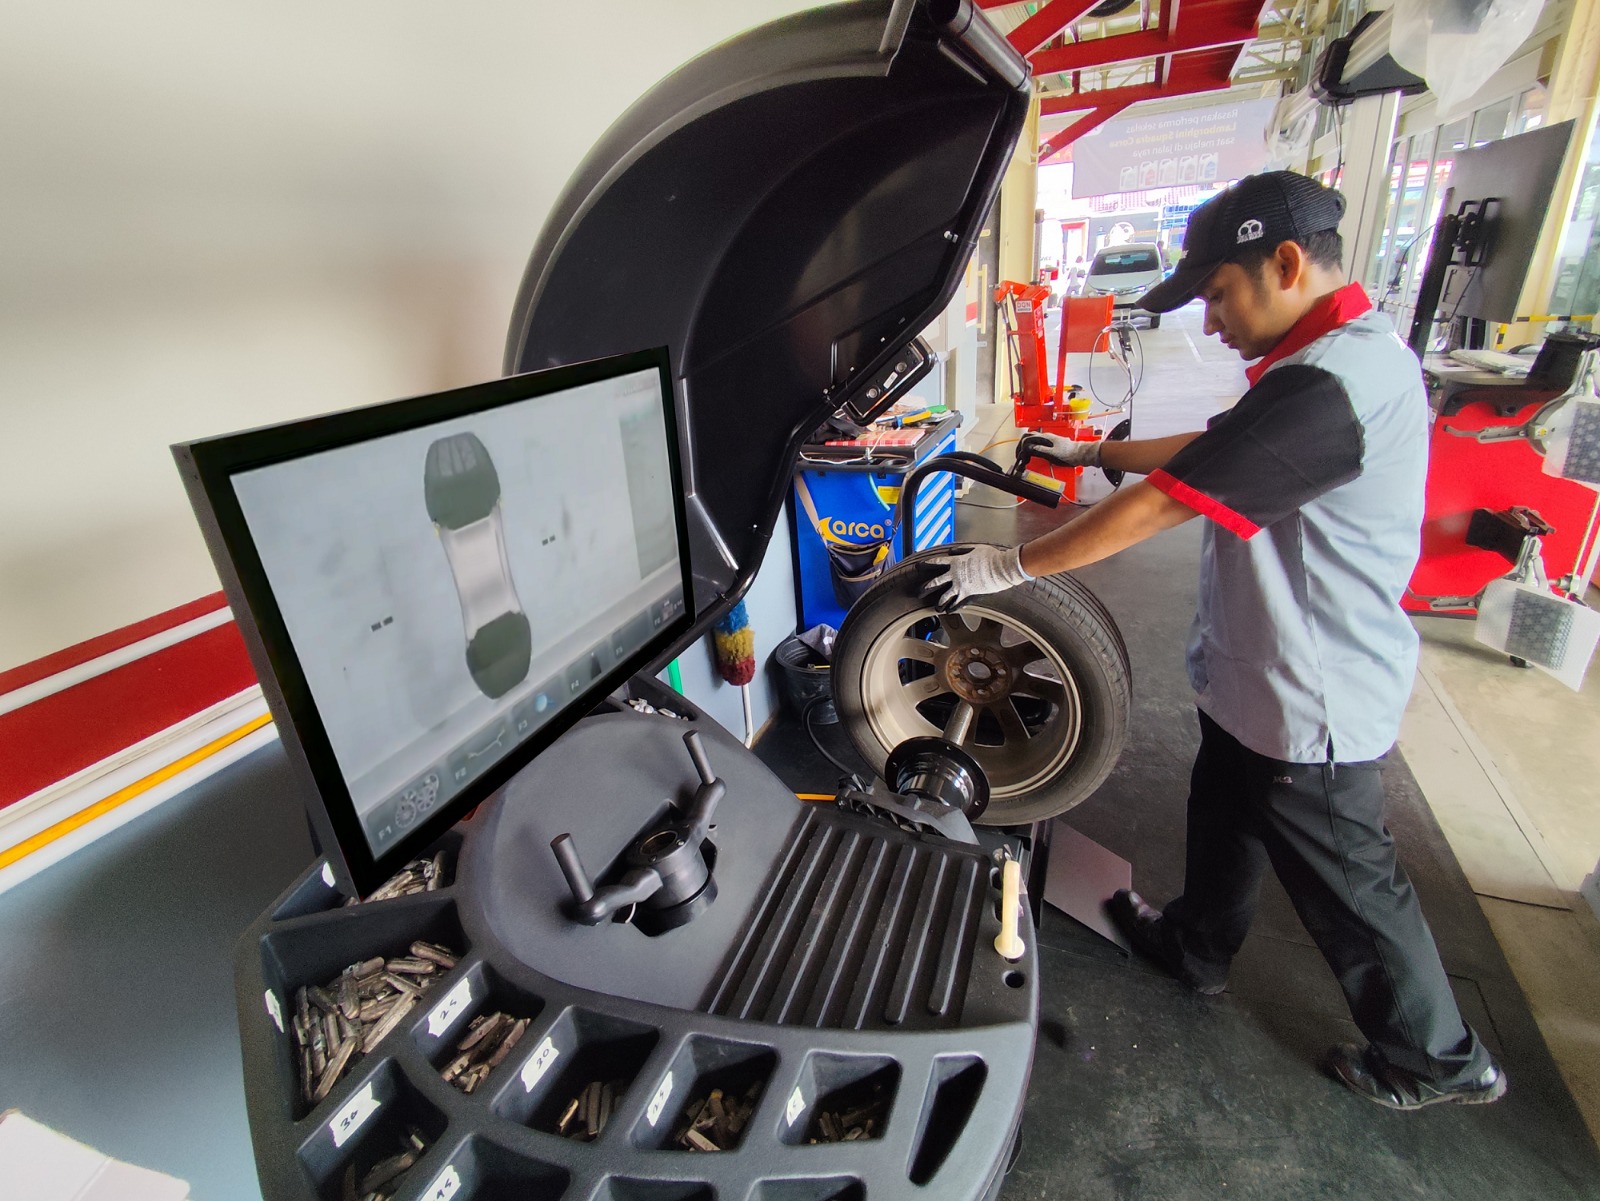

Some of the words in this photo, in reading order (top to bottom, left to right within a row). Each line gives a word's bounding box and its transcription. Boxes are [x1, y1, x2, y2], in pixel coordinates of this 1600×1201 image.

[571, 679, 580, 691] F4
[518, 719, 528, 731] F3
[377, 825, 392, 841] F1
